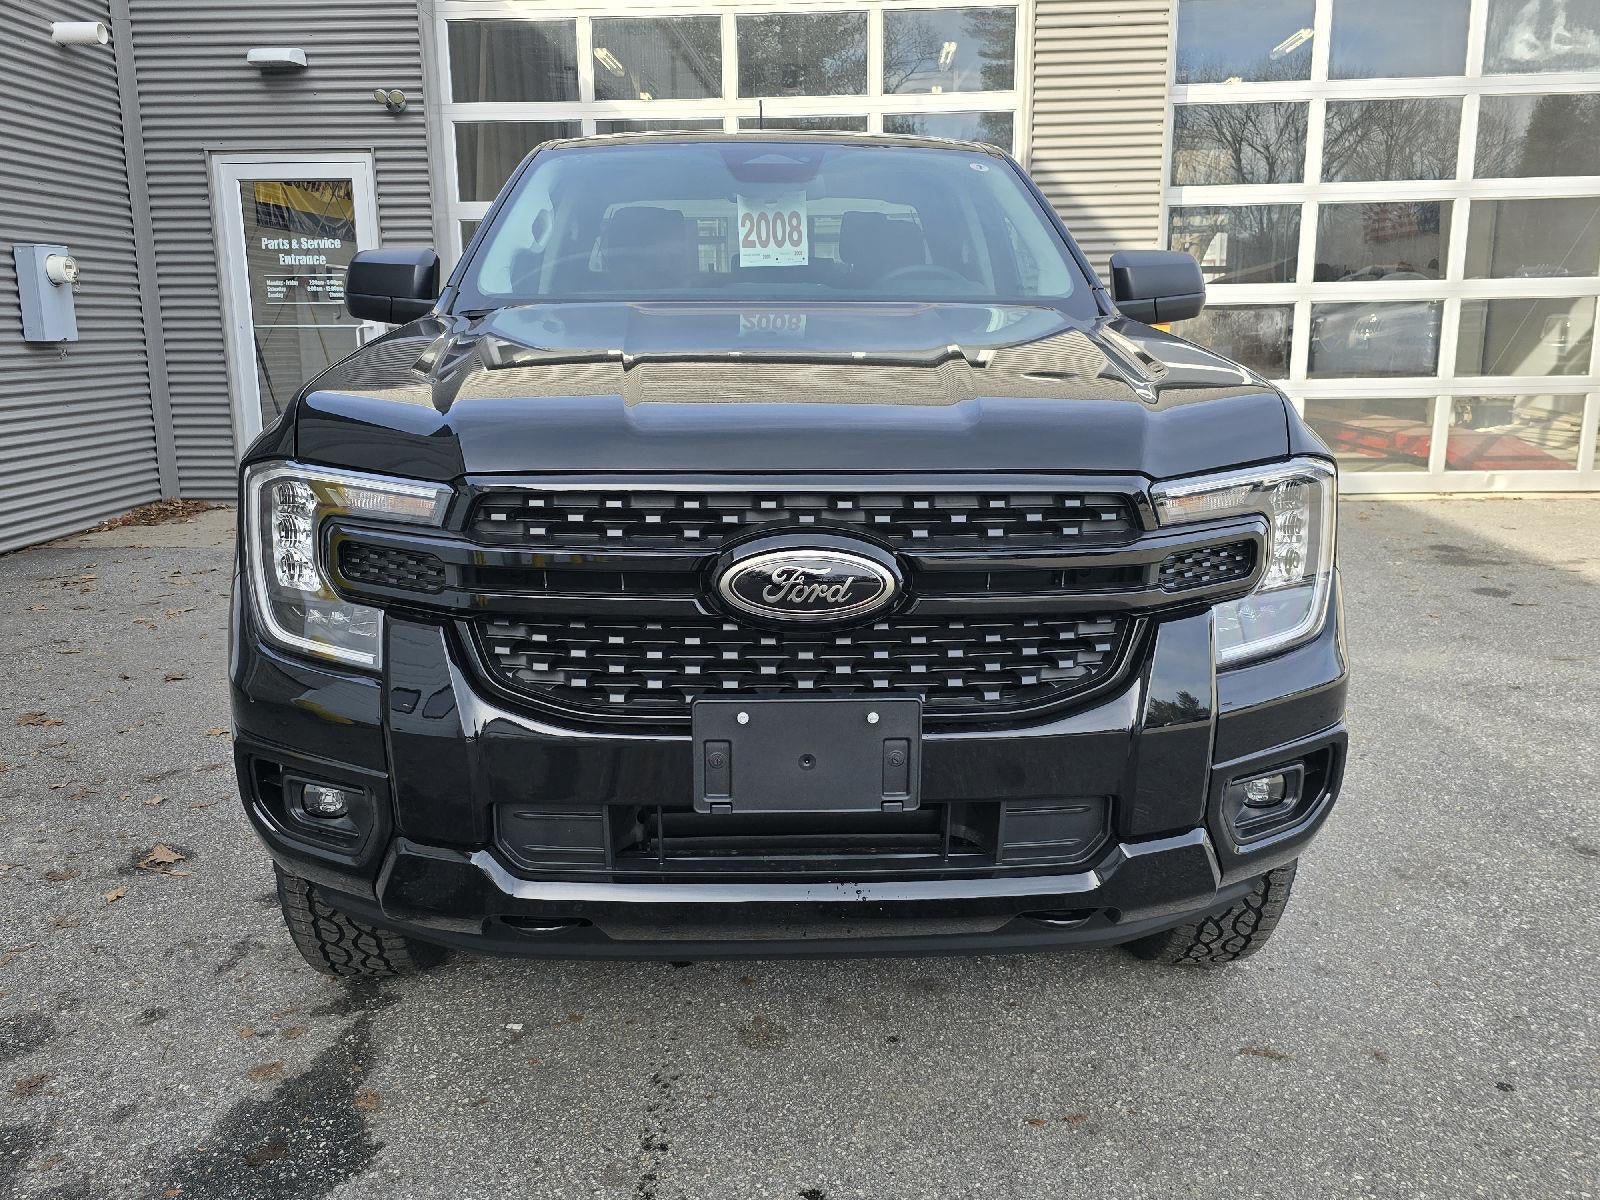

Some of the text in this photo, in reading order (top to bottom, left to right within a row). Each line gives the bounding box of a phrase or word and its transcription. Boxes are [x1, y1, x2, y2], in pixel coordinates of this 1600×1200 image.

[740, 210, 803, 249] 2008
[261, 237, 342, 250] Parts & Service
[279, 253, 327, 266] Entrance
[762, 565, 856, 604] Ford
